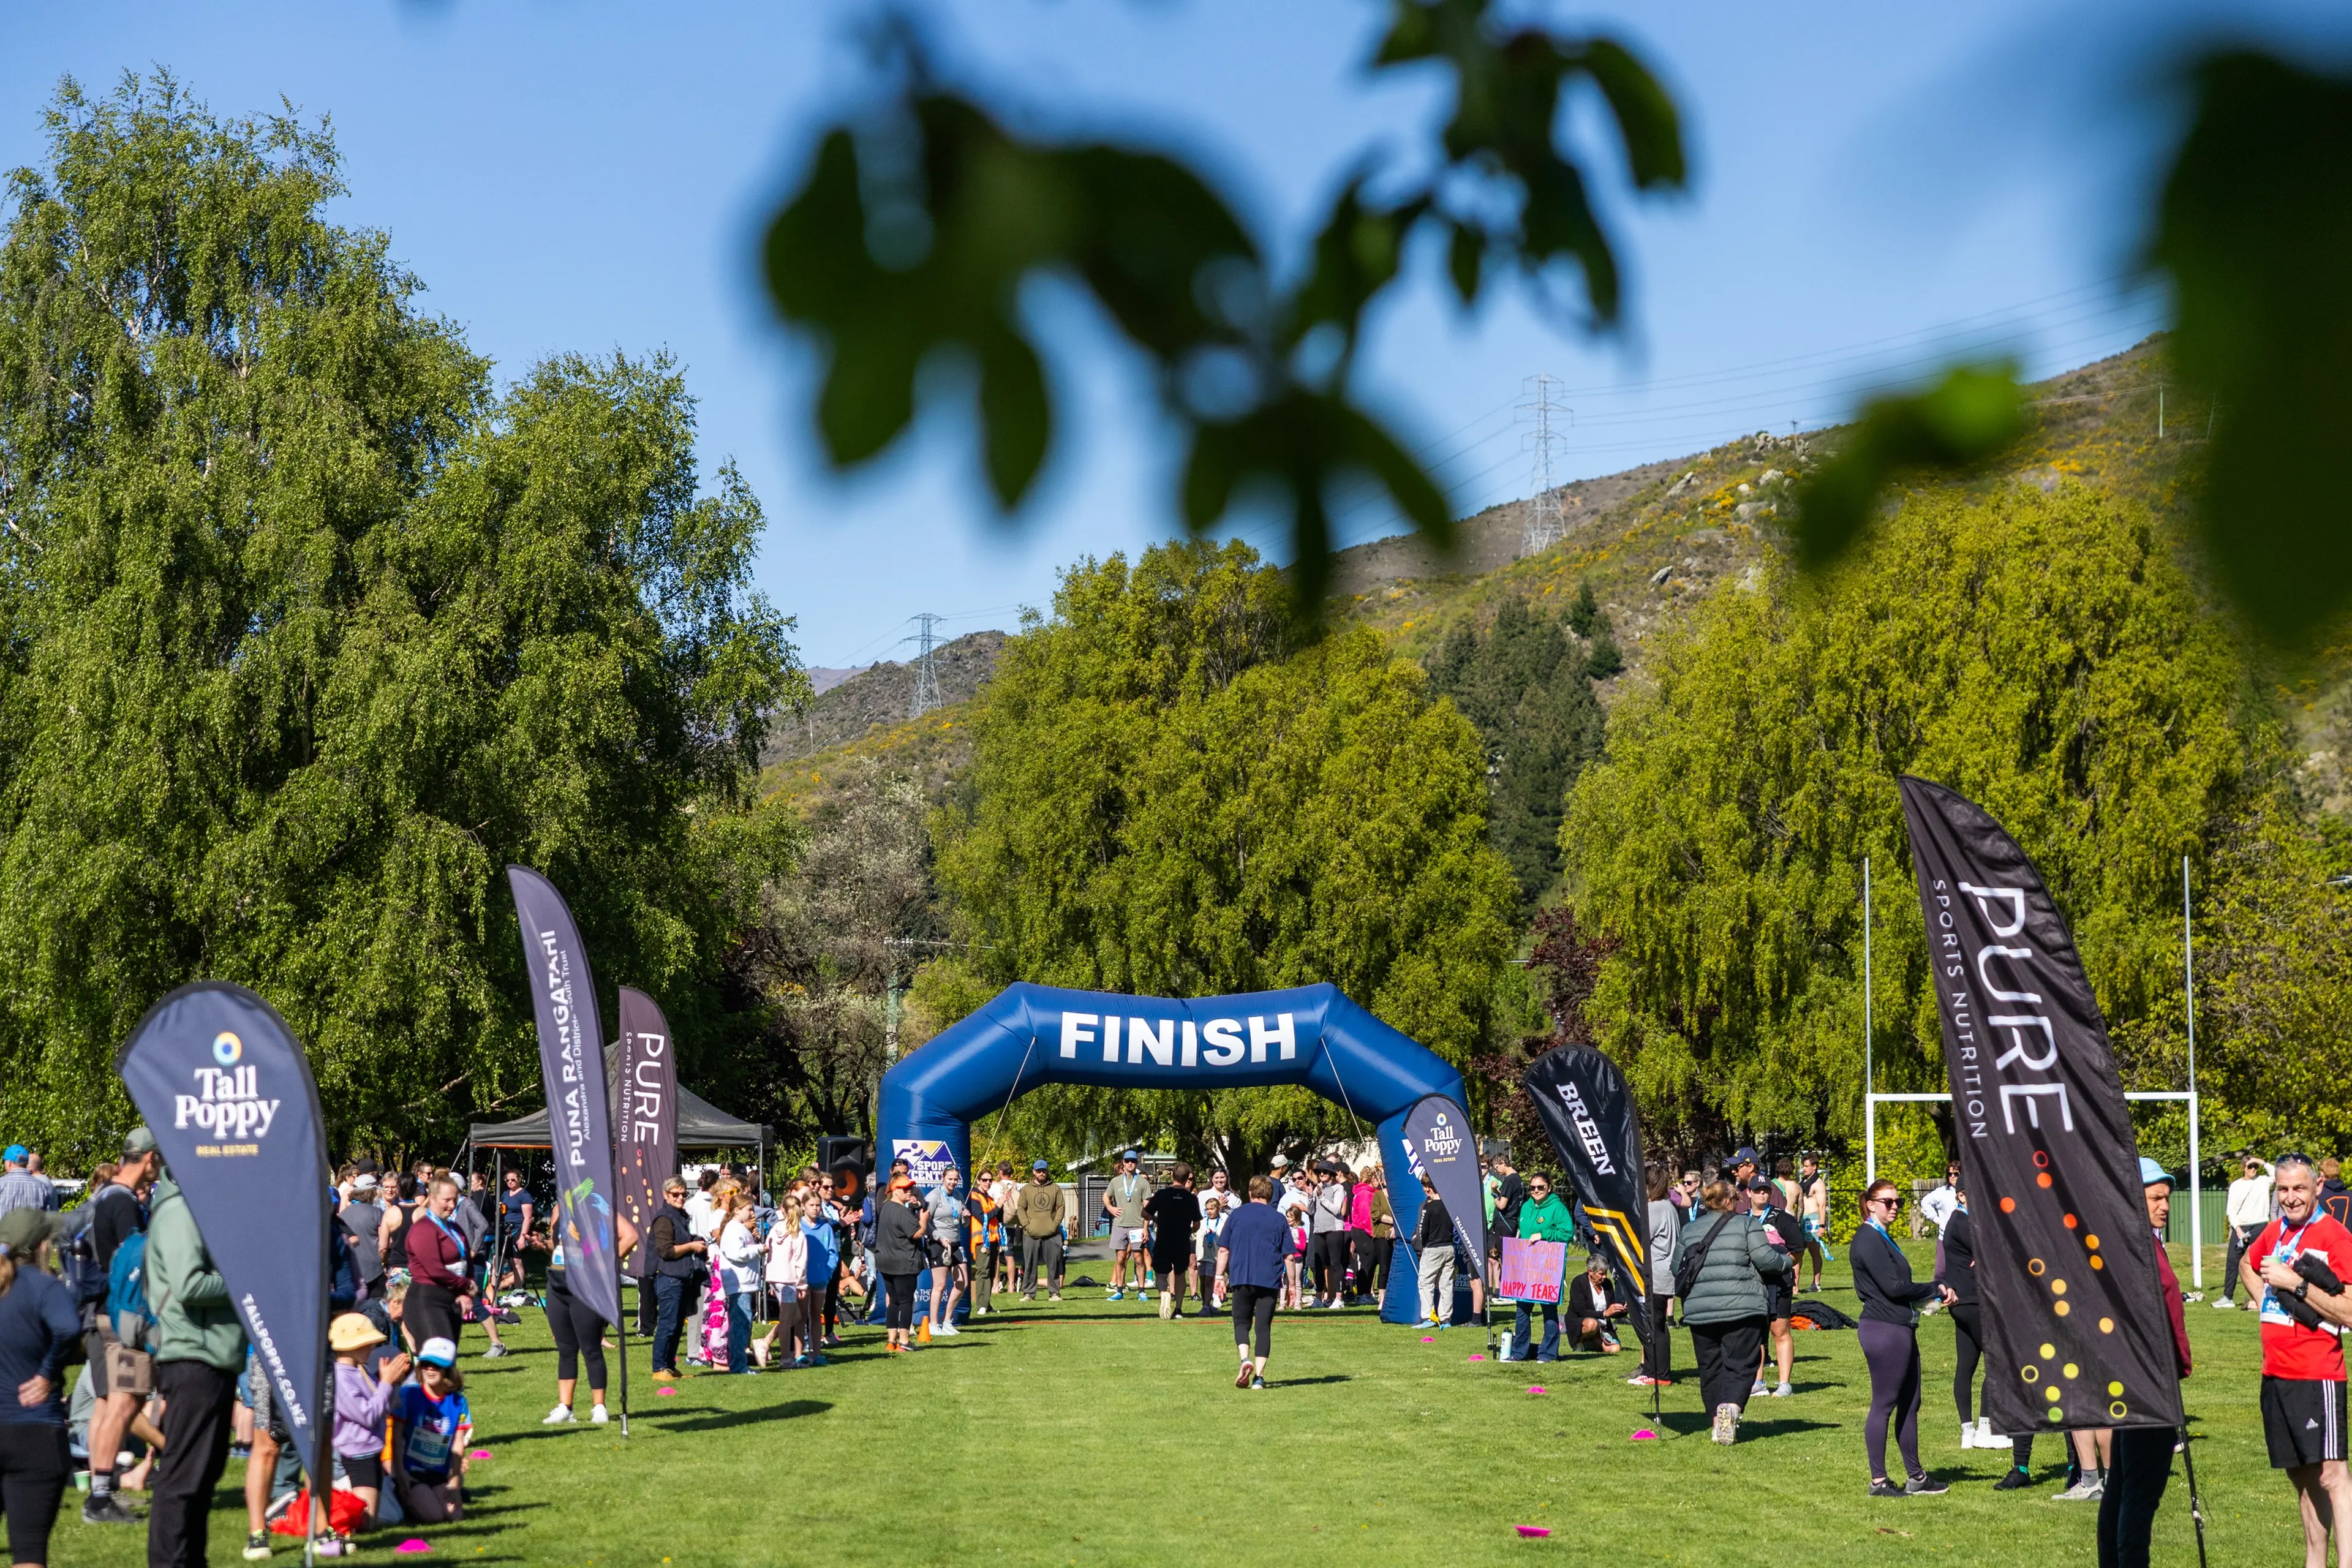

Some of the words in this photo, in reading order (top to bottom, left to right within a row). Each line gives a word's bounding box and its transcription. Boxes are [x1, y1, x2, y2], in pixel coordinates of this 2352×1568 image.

[560, 949, 570, 978] Trust
[540, 930, 578, 1084] RANGATAHI
[1932, 879, 1964, 978] SPORTS
[1951, 991, 1988, 1138] NUTRITION
[1958, 881, 2073, 1135] PURE
[1060, 1011, 1296, 1067] FINISH
[194, 1064, 259, 1102] Tall
[575, 1060, 584, 1081] and
[633, 1032, 665, 1145] PURE
[174, 1099, 281, 1140] Poppy
[565, 1088, 586, 1167] PUNA
[579, 1084, 591, 1142] Alexandra
[620, 1079, 632, 1142] NUTRITION
[1430, 1125, 1455, 1141] Tall
[1556, 1081, 1616, 1176] BREEN
[196, 1145, 222, 1158] REAL
[222, 1144, 259, 1157] ESTATE
[1424, 1138, 1463, 1156] Poppy
[1455, 1216, 1482, 1267] TALLPOPPY.CO.NZ
[1502, 1280, 1526, 1297] HAPPY
[1531, 1283, 1559, 1301] TEARS
[241, 1292, 307, 1429] TALLPOPPY.CO.NZ
